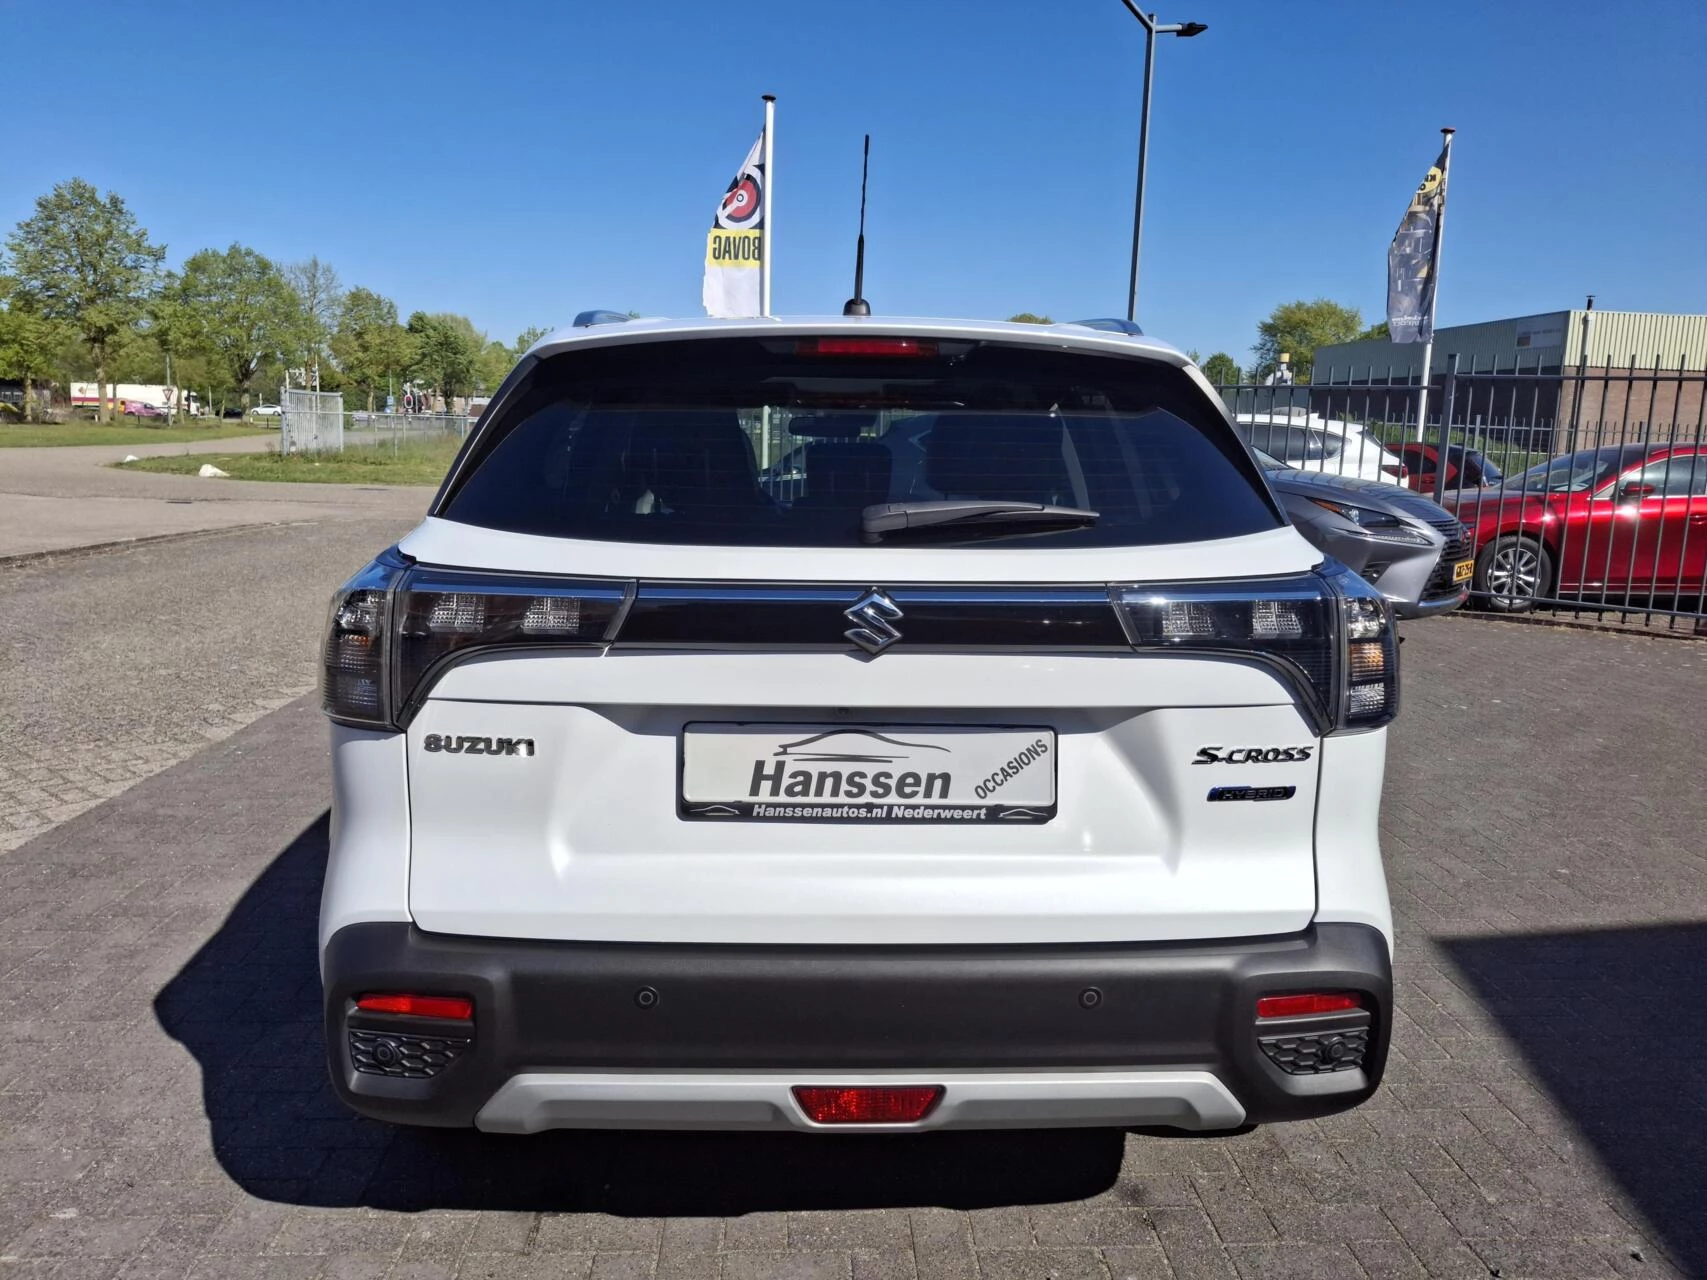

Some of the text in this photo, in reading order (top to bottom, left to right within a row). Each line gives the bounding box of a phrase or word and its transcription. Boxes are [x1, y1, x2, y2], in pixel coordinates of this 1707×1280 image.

[424, 733, 535, 756] SUZUKI
[749, 760, 952, 800] Hanssen
[974, 738, 1049, 800] OCCASIONS
[1222, 788, 1285, 801] HYBRID
[752, 805, 987, 819] Hanssenautos.nl Nederweert
